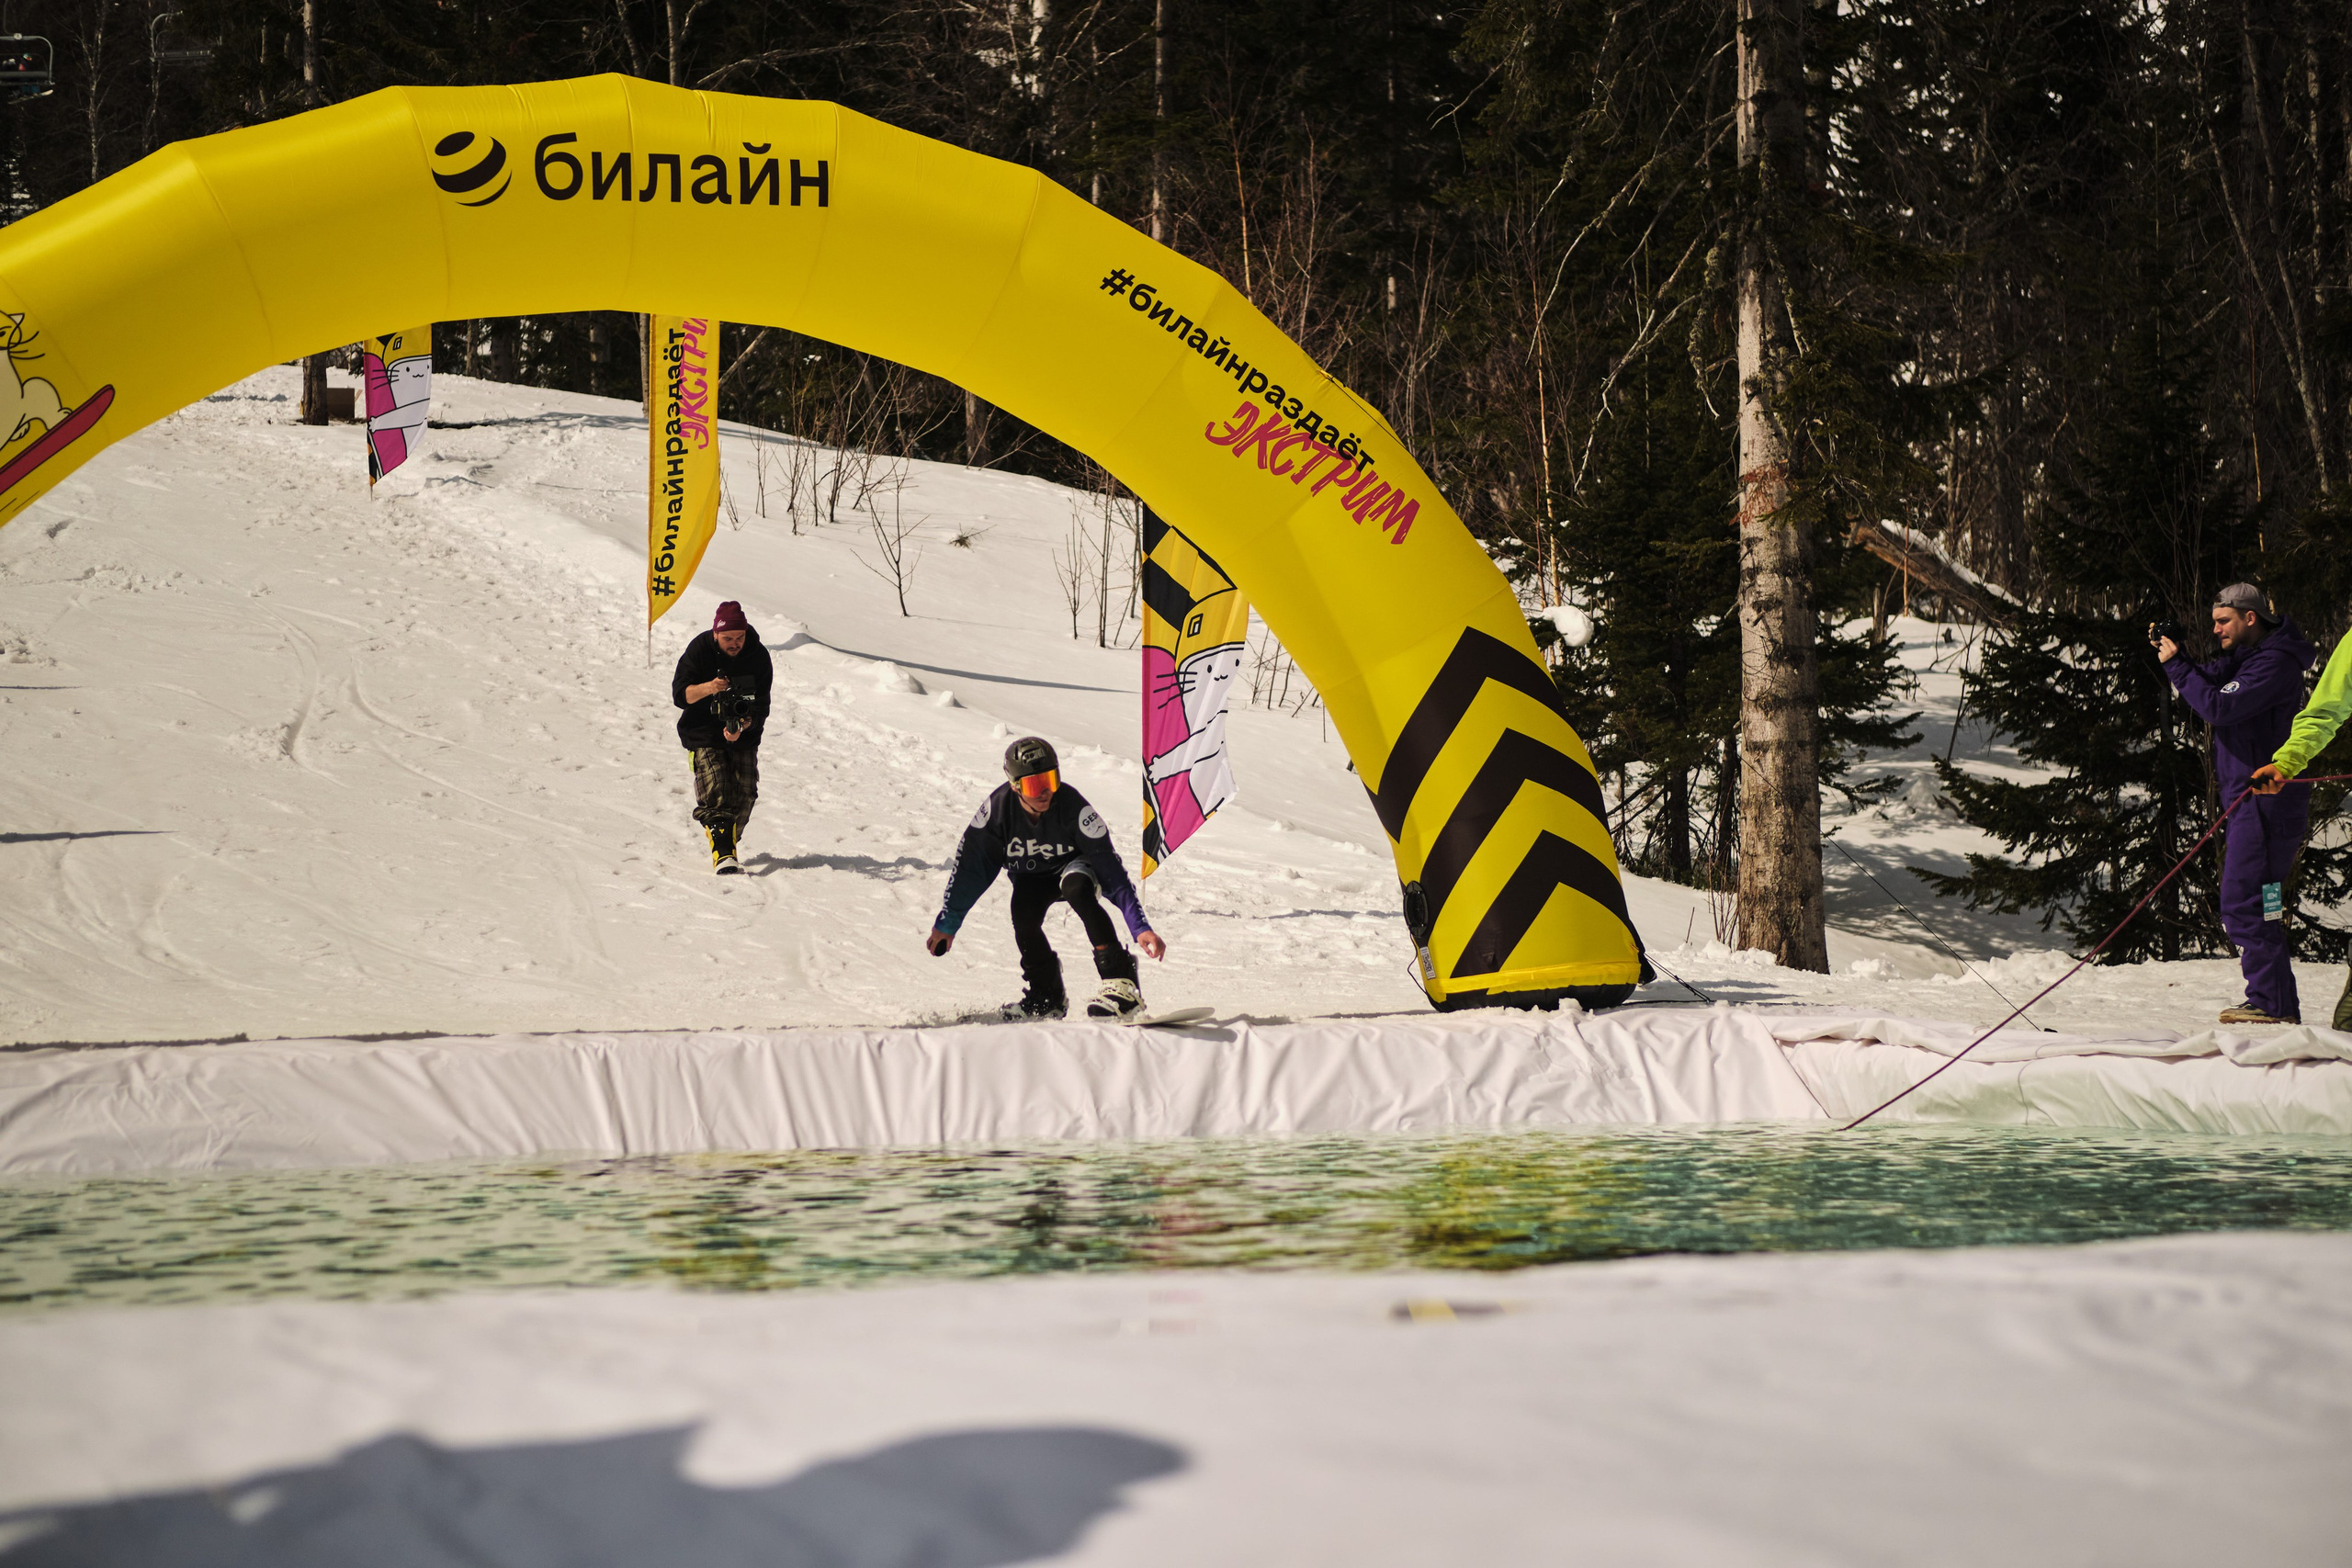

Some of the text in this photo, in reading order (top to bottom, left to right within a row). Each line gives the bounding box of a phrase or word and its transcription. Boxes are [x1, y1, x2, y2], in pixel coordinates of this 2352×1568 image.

[535, 131, 829, 208] билайн
[678, 318, 709, 449] ЭКСТРИ
[1099, 267, 1375, 473] #билайнраздаёт
[651, 328, 688, 597] #билайнраздаёт
[1204, 400, 1421, 545] ЭКСТРИМ
[1081, 811, 1099, 827] GES
